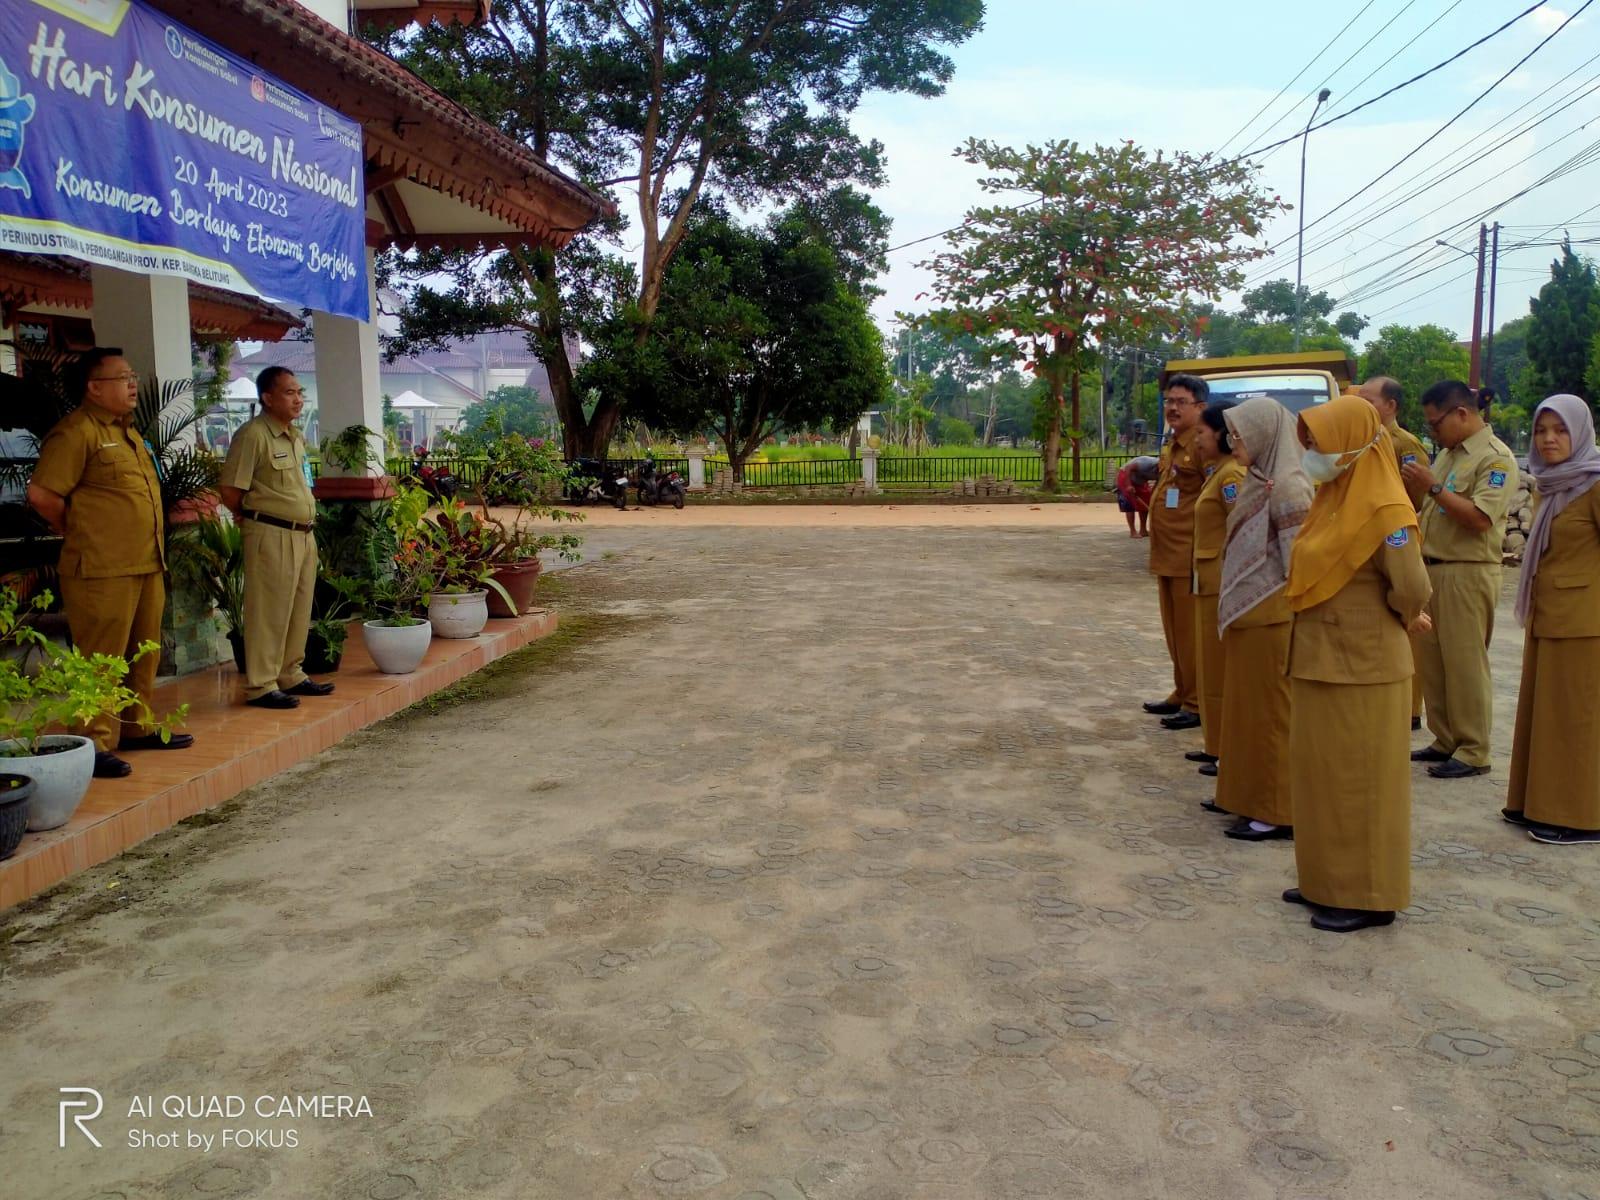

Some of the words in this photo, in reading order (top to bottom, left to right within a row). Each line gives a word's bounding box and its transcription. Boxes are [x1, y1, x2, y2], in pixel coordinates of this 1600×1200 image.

[28, 21, 118, 107] Hari
[124, 60, 267, 163] Konsumen
[271, 135, 358, 208] Nasional
[55, 156, 163, 217] Konsumen
[169, 188, 241, 254] Berdaya
[246, 222, 305, 259] Ekonomi
[307, 242, 357, 282] Berjaya
[174, 156, 198, 186] 20
[204, 168, 245, 204] April
[248, 184, 288, 218] 2023
[1, 229, 79, 251] PERINDUSTRIAN
[86, 243, 133, 264] PERDAGANGAN
[134, 256, 159, 269] PROV.
[162, 258, 182, 271] KEP.
[202, 268, 230, 285] BELITUNG
